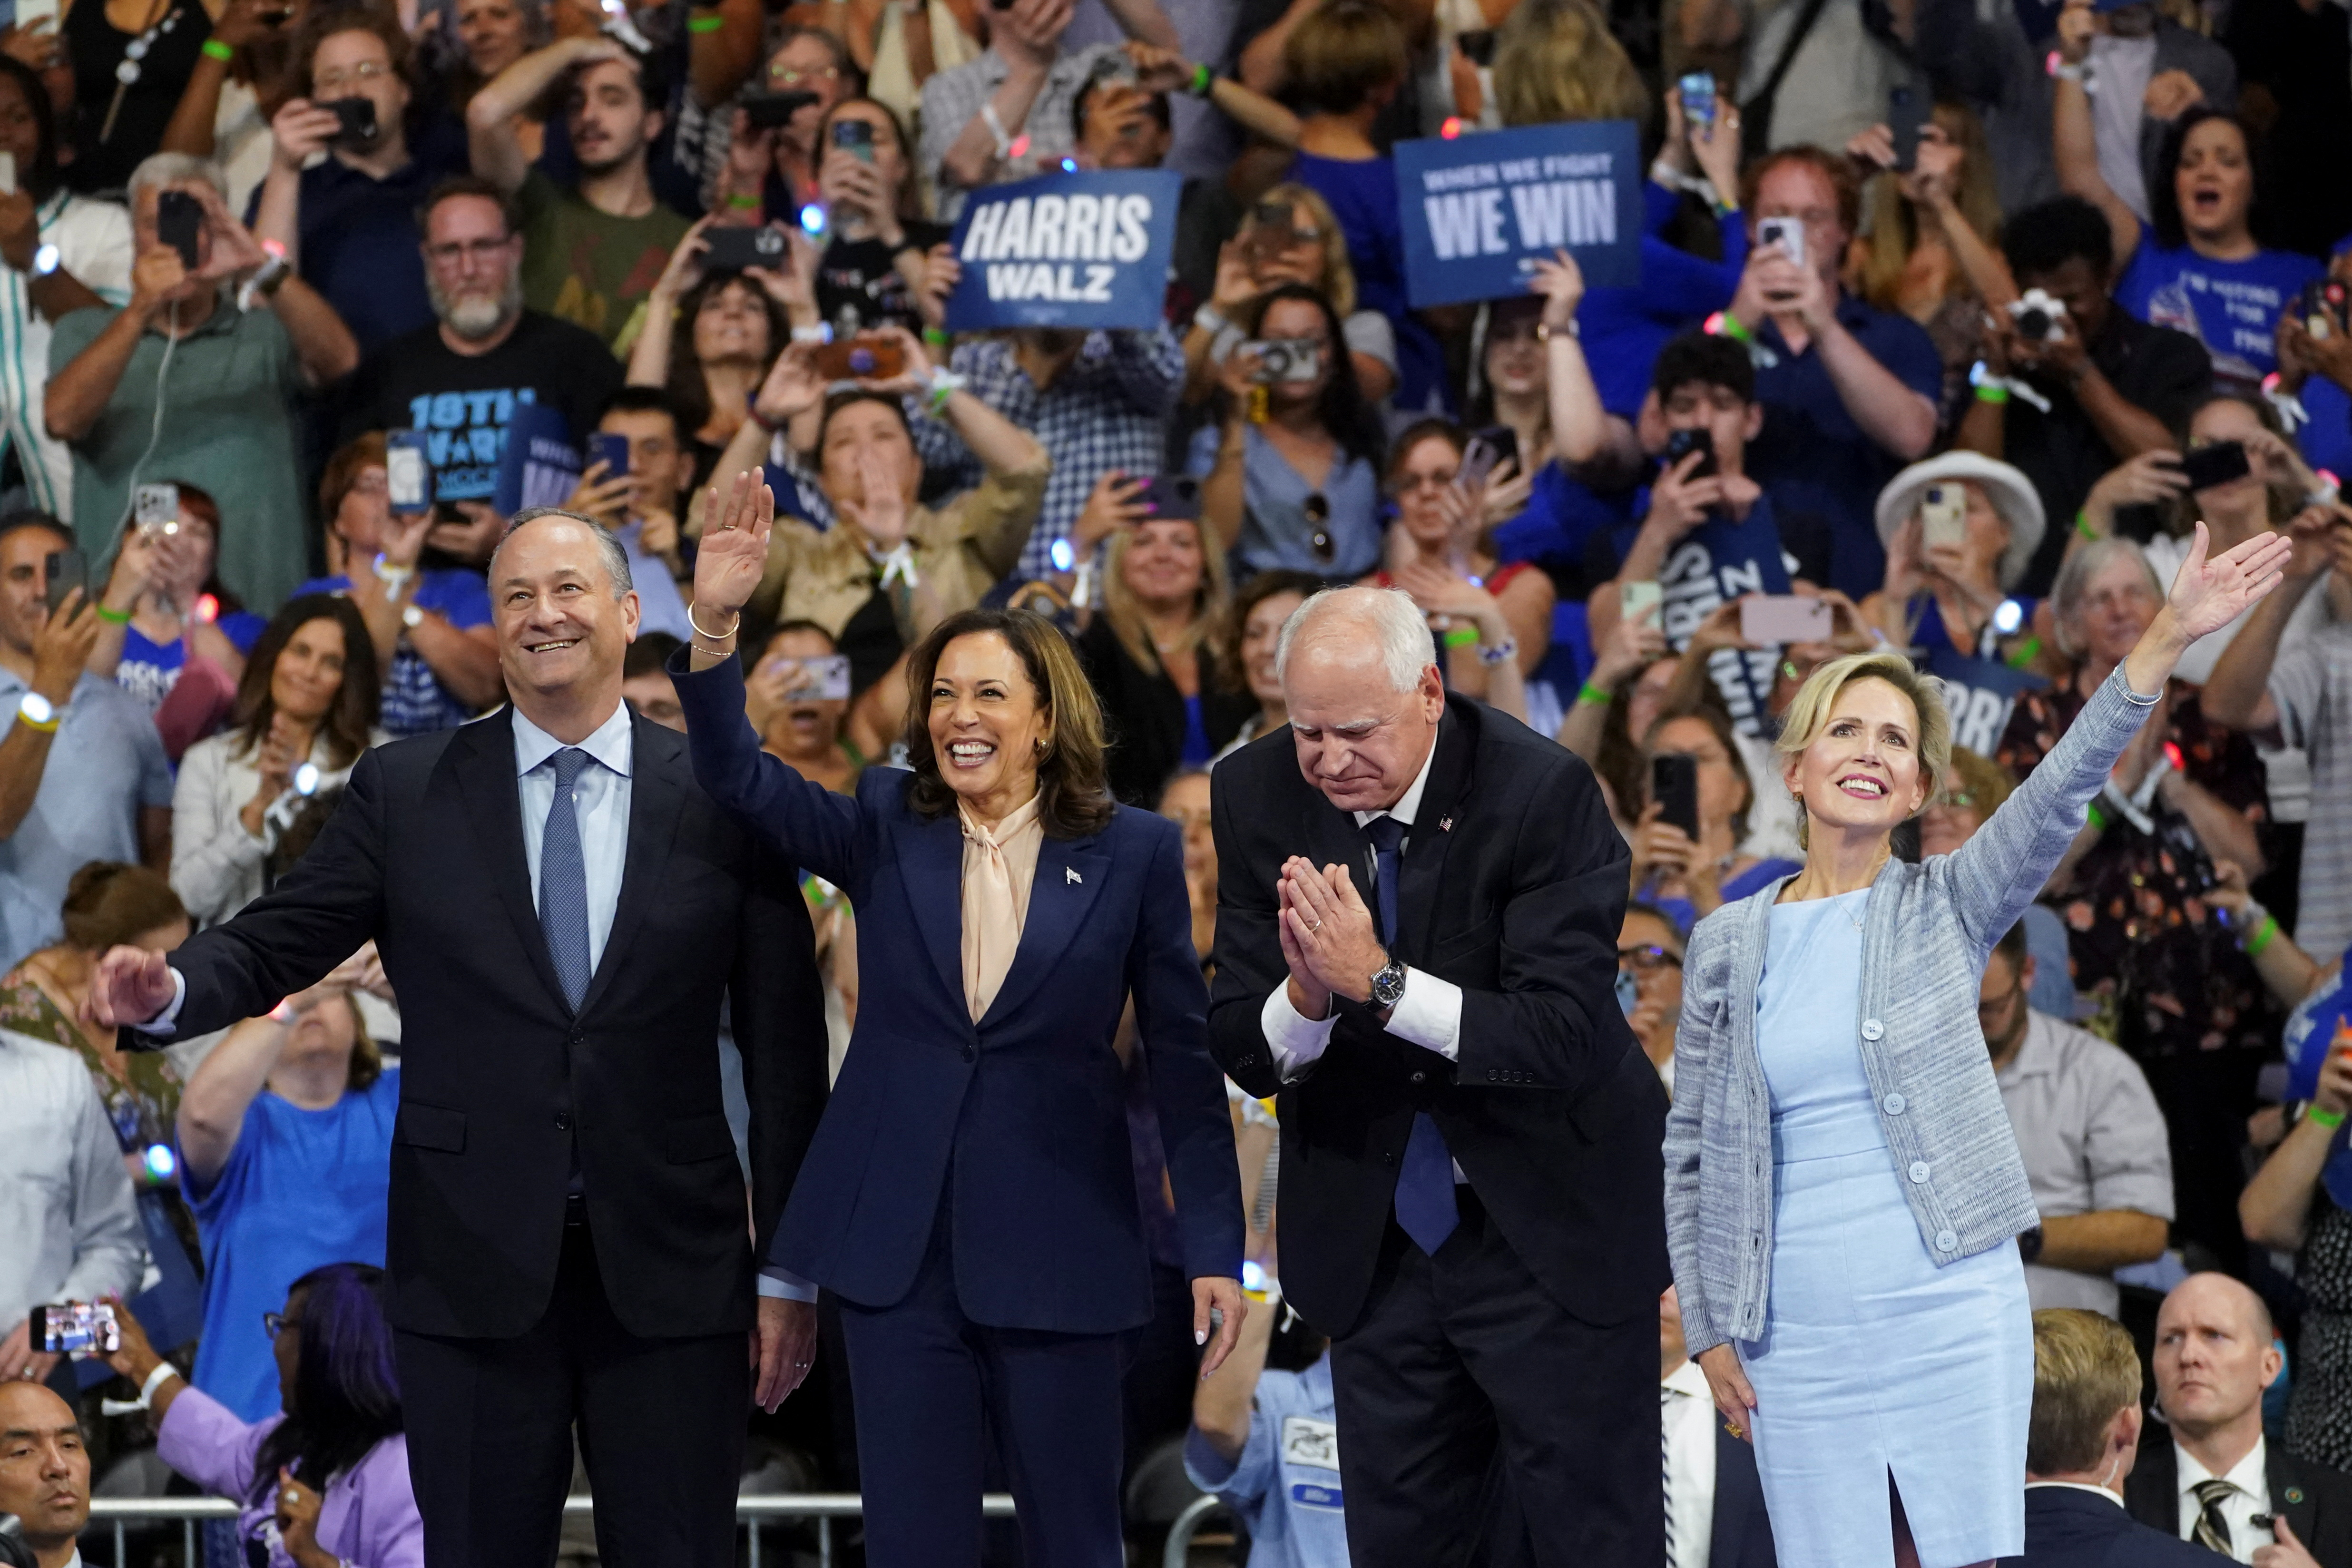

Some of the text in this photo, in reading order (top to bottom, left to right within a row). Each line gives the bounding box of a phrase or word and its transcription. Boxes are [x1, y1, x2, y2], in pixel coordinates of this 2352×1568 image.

[1421, 152, 1613, 192] WHEN WE FIGHT
[960, 193, 1153, 264] HARRIS
[1424, 178, 1618, 262] WE WIN
[986, 263, 1117, 303] WALZ
